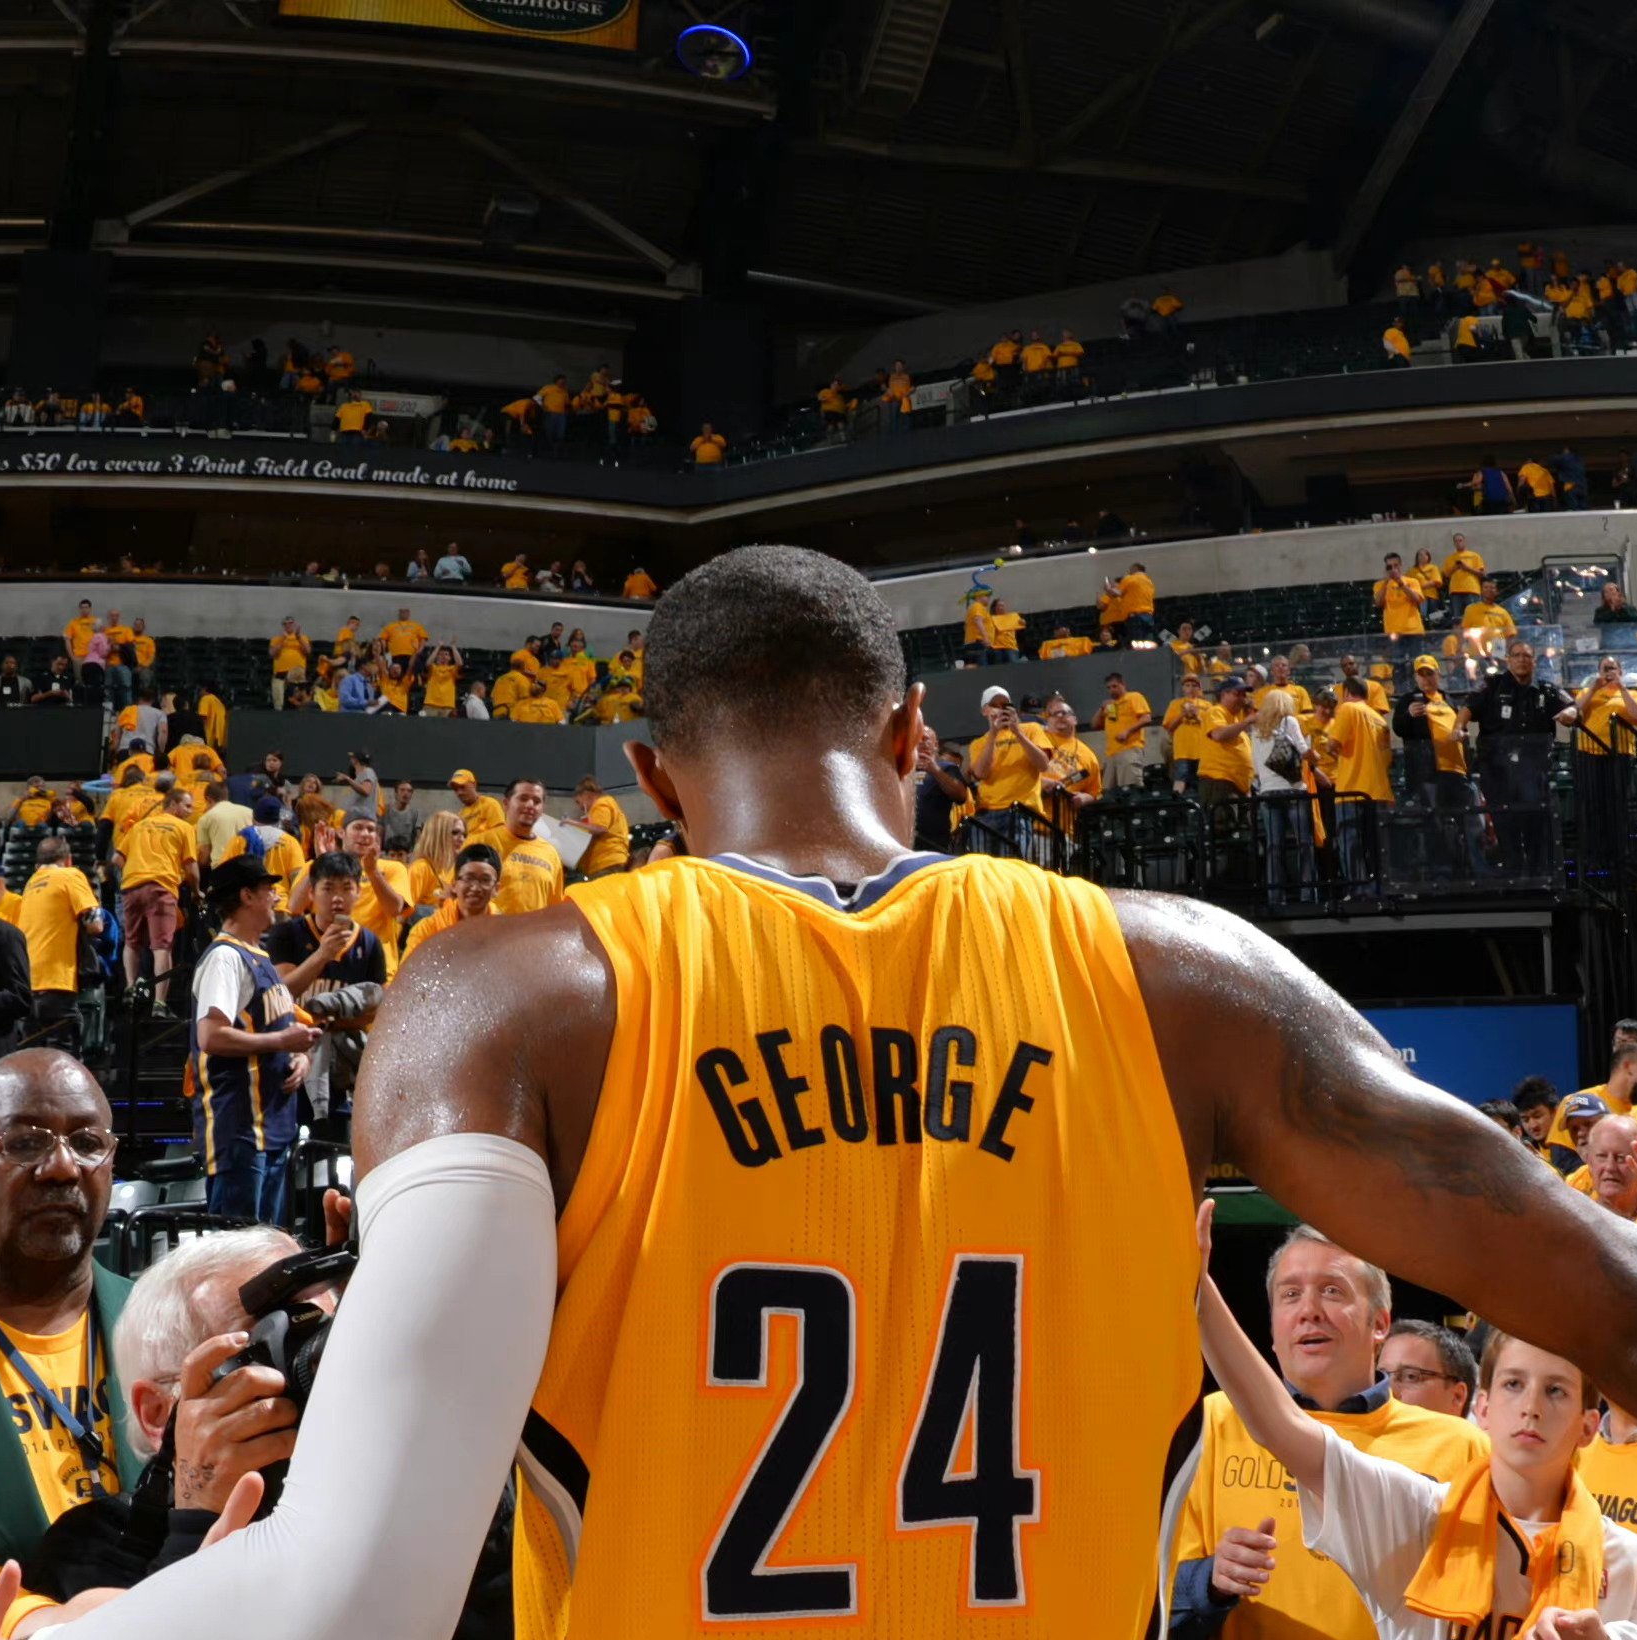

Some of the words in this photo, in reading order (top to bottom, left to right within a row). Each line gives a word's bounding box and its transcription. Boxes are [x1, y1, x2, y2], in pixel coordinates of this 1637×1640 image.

[168, 454, 184, 473] 3
[188, 455, 246, 475] Point
[253, 457, 308, 478] Field
[313, 460, 366, 481] Goal
[372, 465, 430, 485] made
[435, 471, 458, 487] at
[463, 470, 518, 492] home
[695, 1024, 1054, 1169] GEORGE
[700, 1253, 1042, 1622] 24
